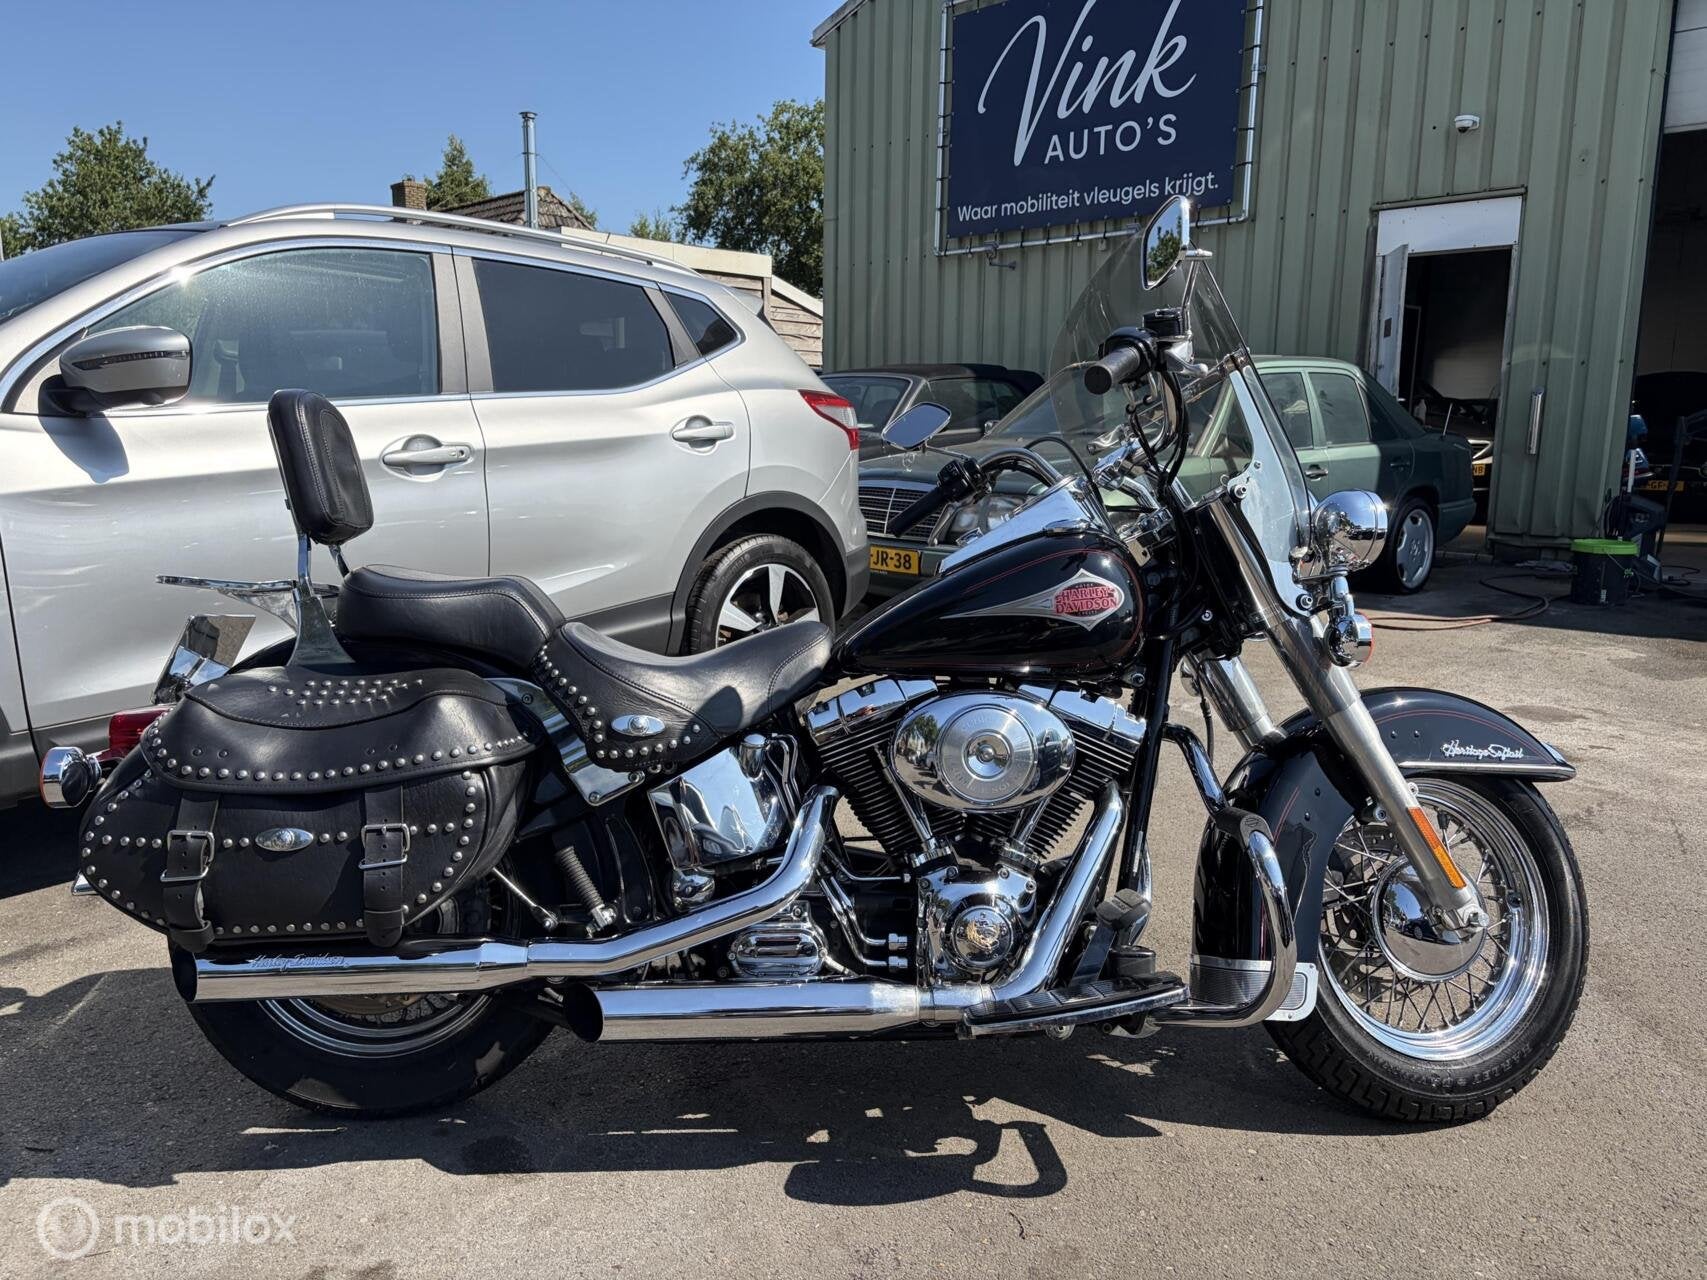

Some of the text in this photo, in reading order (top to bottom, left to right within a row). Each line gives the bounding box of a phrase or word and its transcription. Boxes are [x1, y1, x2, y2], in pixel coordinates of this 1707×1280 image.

[977, 0, 1197, 166] Vink
[1044, 113, 1177, 164] AUTO'S
[957, 171, 1219, 222] Waar mobiliteit vleugels krijgt.
[1056, 597, 1117, 614] DAVIDSON
